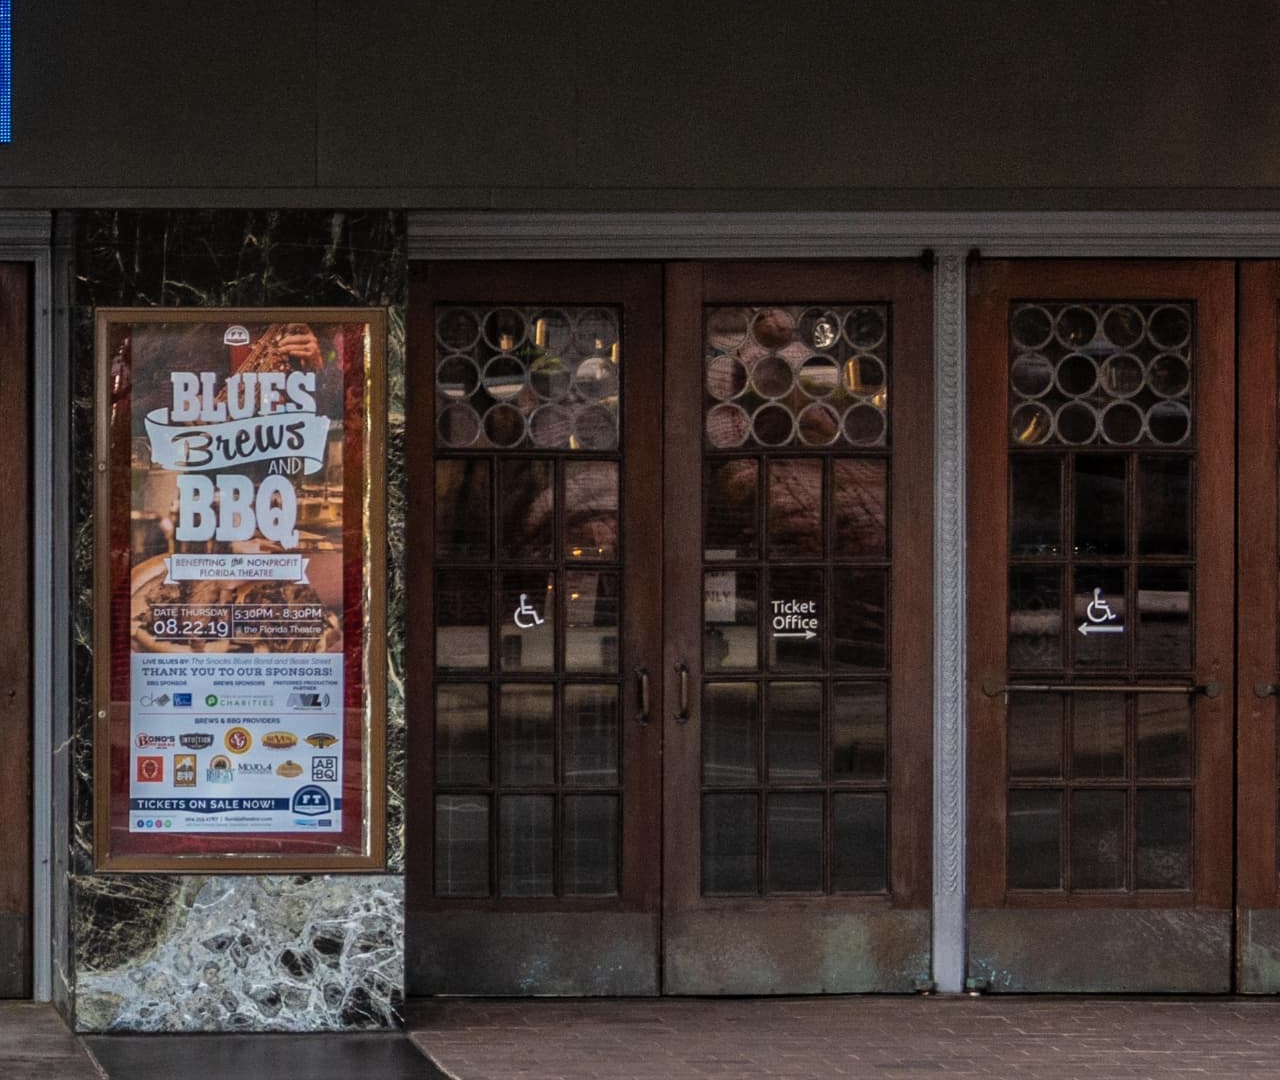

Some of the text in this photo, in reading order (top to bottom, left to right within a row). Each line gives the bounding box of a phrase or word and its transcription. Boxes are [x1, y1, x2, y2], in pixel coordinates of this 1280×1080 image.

[170, 371, 316, 422] BLUES
[171, 421, 306, 467] Brews
[268, 457, 303, 475] AND
[175, 474, 300, 550] BBQ
[175, 558, 226, 567] BENEFITING
[247, 559, 298, 567] NONPROFIT
[200, 568, 273, 577] FLORIDA THEATRE
[153, 608, 179, 617] DATE
[181, 608, 228, 617] THURSDAY
[771, 600, 816, 614] Ticket
[153, 619, 229, 637] 08.22.19
[244, 625, 322, 634] the Florida Theatre
[772, 615, 818, 630] Office
[142, 667, 332, 677] THANK YOU TO OUR SPONSORS!
[137, 800, 275, 809] TICKETS ON SALE NOW!
